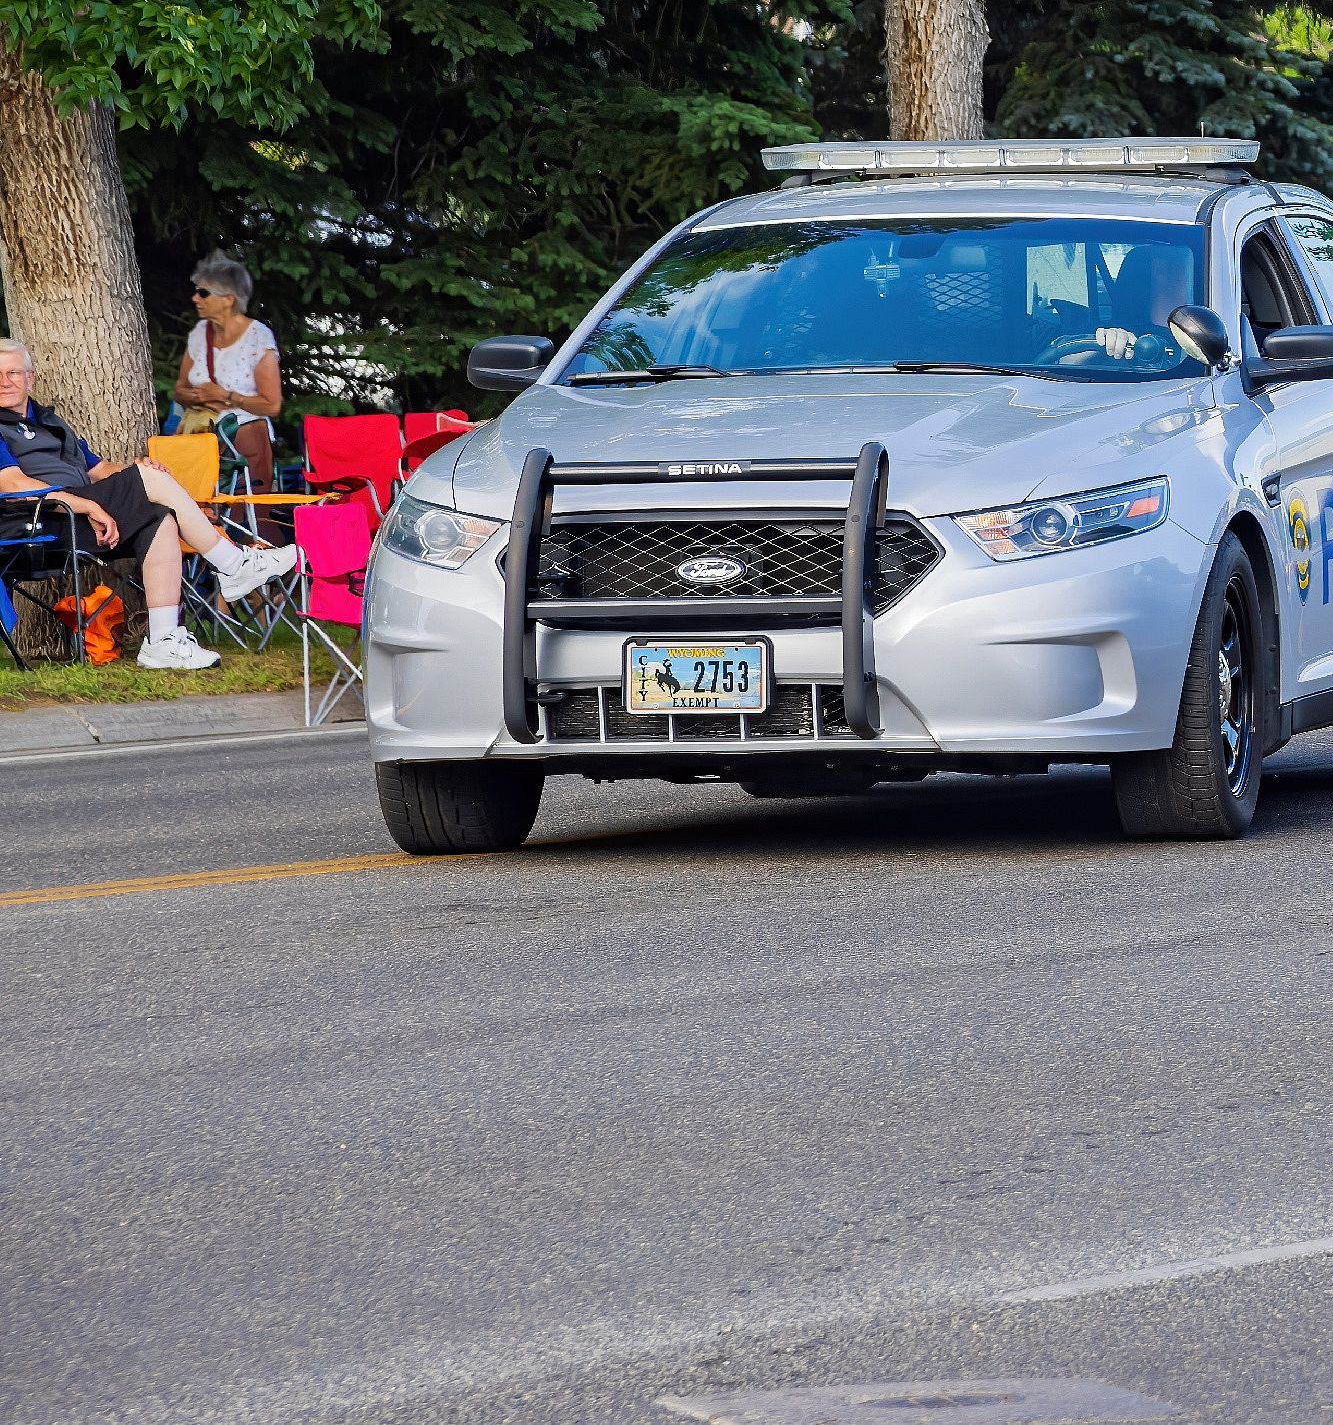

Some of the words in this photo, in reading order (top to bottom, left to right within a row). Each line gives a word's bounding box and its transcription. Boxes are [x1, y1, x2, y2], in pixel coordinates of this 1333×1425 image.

[668, 463, 743, 476] SETINA
[689, 562, 729, 579] Ford
[666, 648, 726, 658] WYOMING
[638, 655, 648, 702] CITY
[693, 660, 749, 693] 2753
[672, 697, 720, 708] EXEMPT
